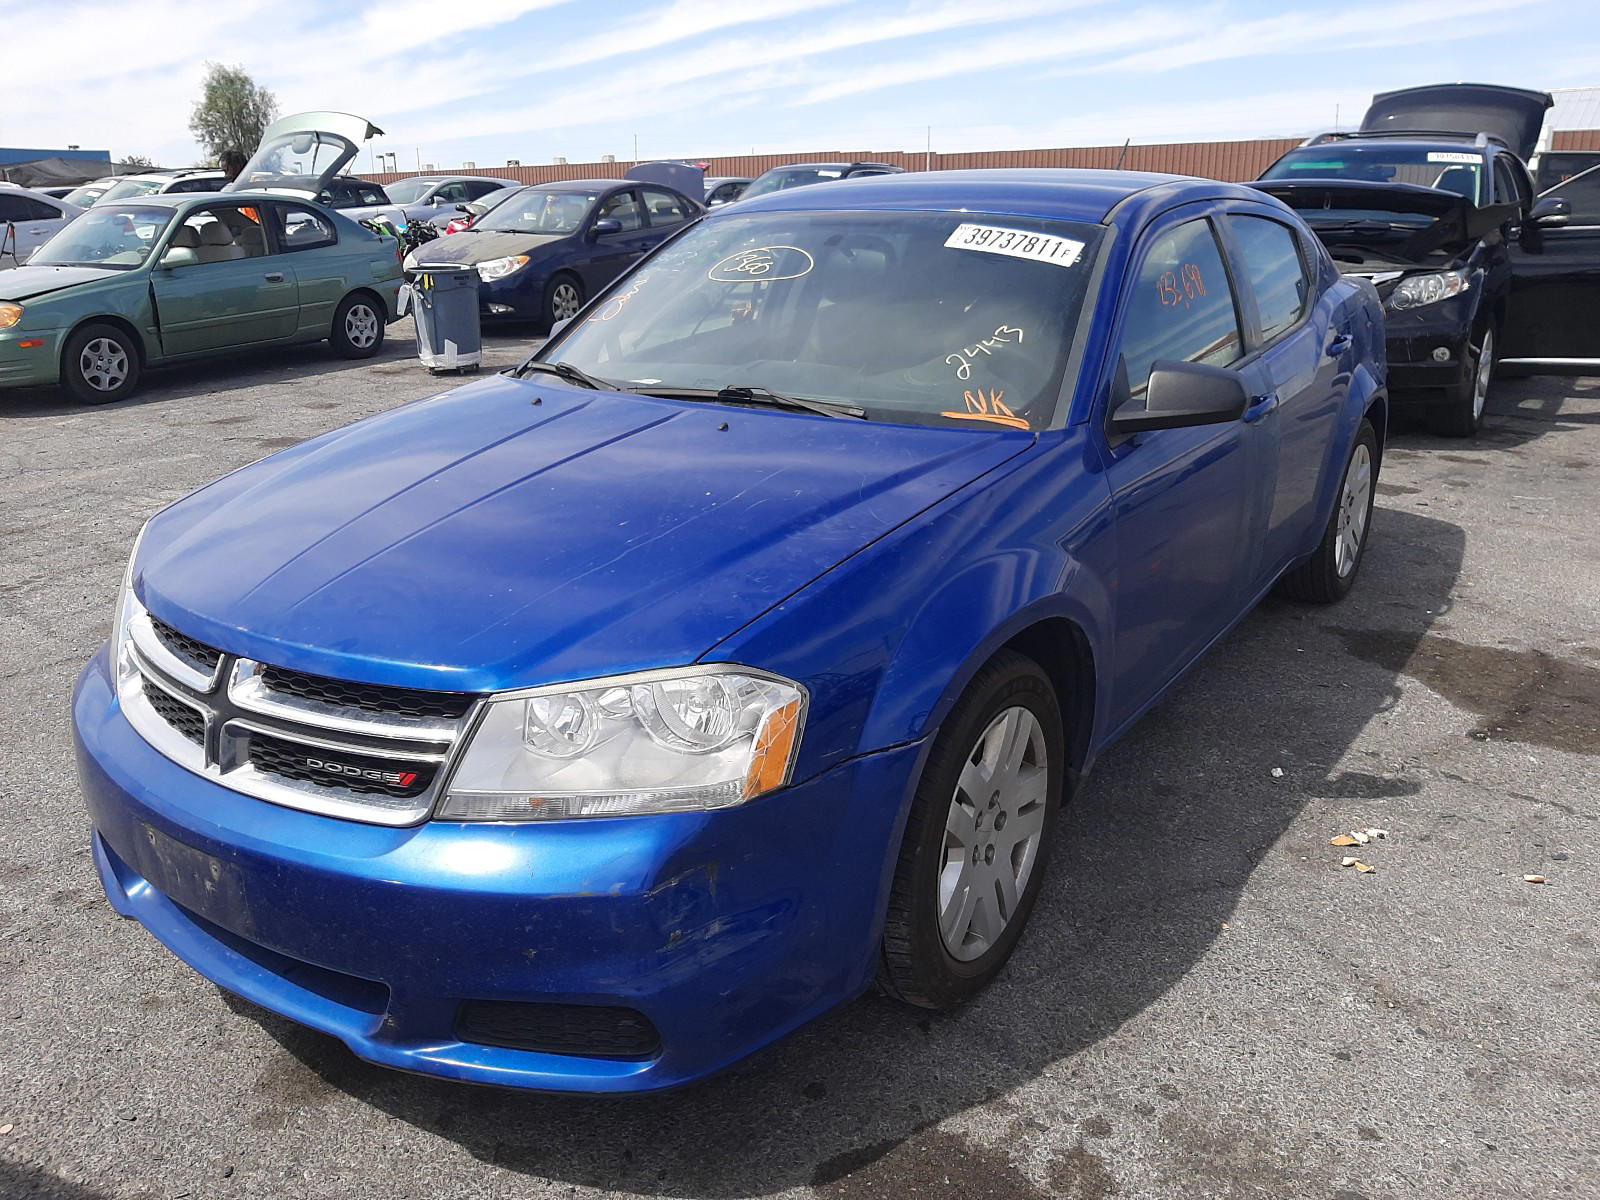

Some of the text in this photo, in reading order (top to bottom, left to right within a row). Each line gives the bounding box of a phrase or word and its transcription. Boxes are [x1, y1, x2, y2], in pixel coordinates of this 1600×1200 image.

[963, 227, 1063, 258] 39737811
[963, 387, 1016, 418] NK
[306, 758, 401, 783] DODGE
